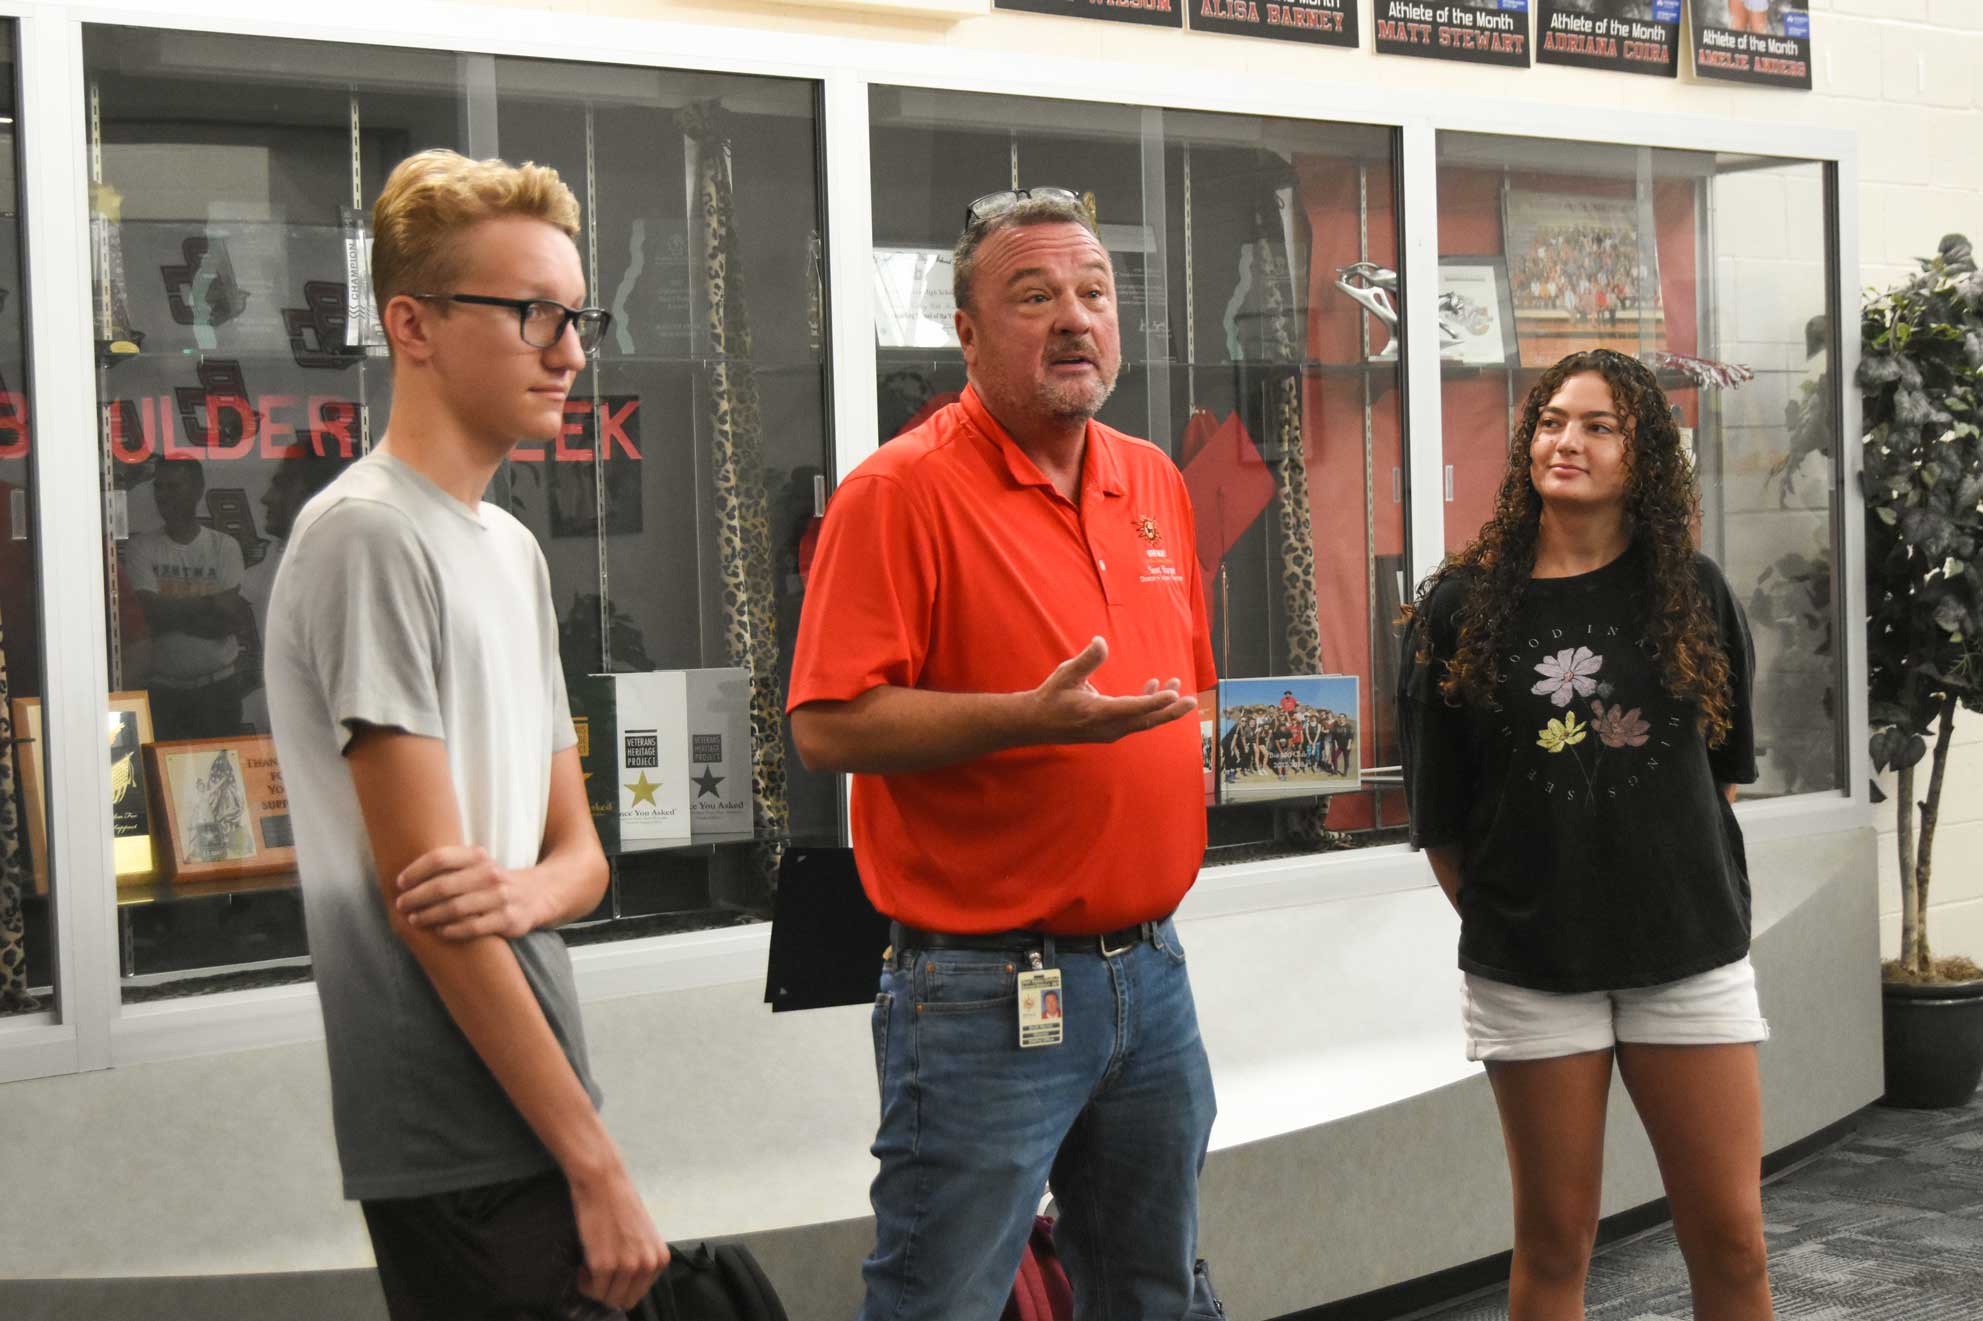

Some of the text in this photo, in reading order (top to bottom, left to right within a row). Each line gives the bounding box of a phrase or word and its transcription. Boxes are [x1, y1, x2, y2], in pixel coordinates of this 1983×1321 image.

[1200, 0, 1344, 32] ALISA BARNEY
[1388, 1, 1514, 30] Athlete of the Month
[1550, 13, 1666, 41] Athlete of the Month
[1377, 19, 1524, 54] MATT STEWART
[1543, 31, 1617, 58] ADRIANA
[1703, 29, 1798, 56] Athlete of the Month
[349, 243, 359, 301] CHAMPION
[626, 738, 656, 747] VETERANS
[627, 748, 656, 757] HERITAGE
[627, 757, 657, 766] PROJECT
[634, 809, 650, 817] You
[652, 808, 675, 817] Asked
[699, 801, 716, 810] You
[718, 801, 744, 810] Asked
